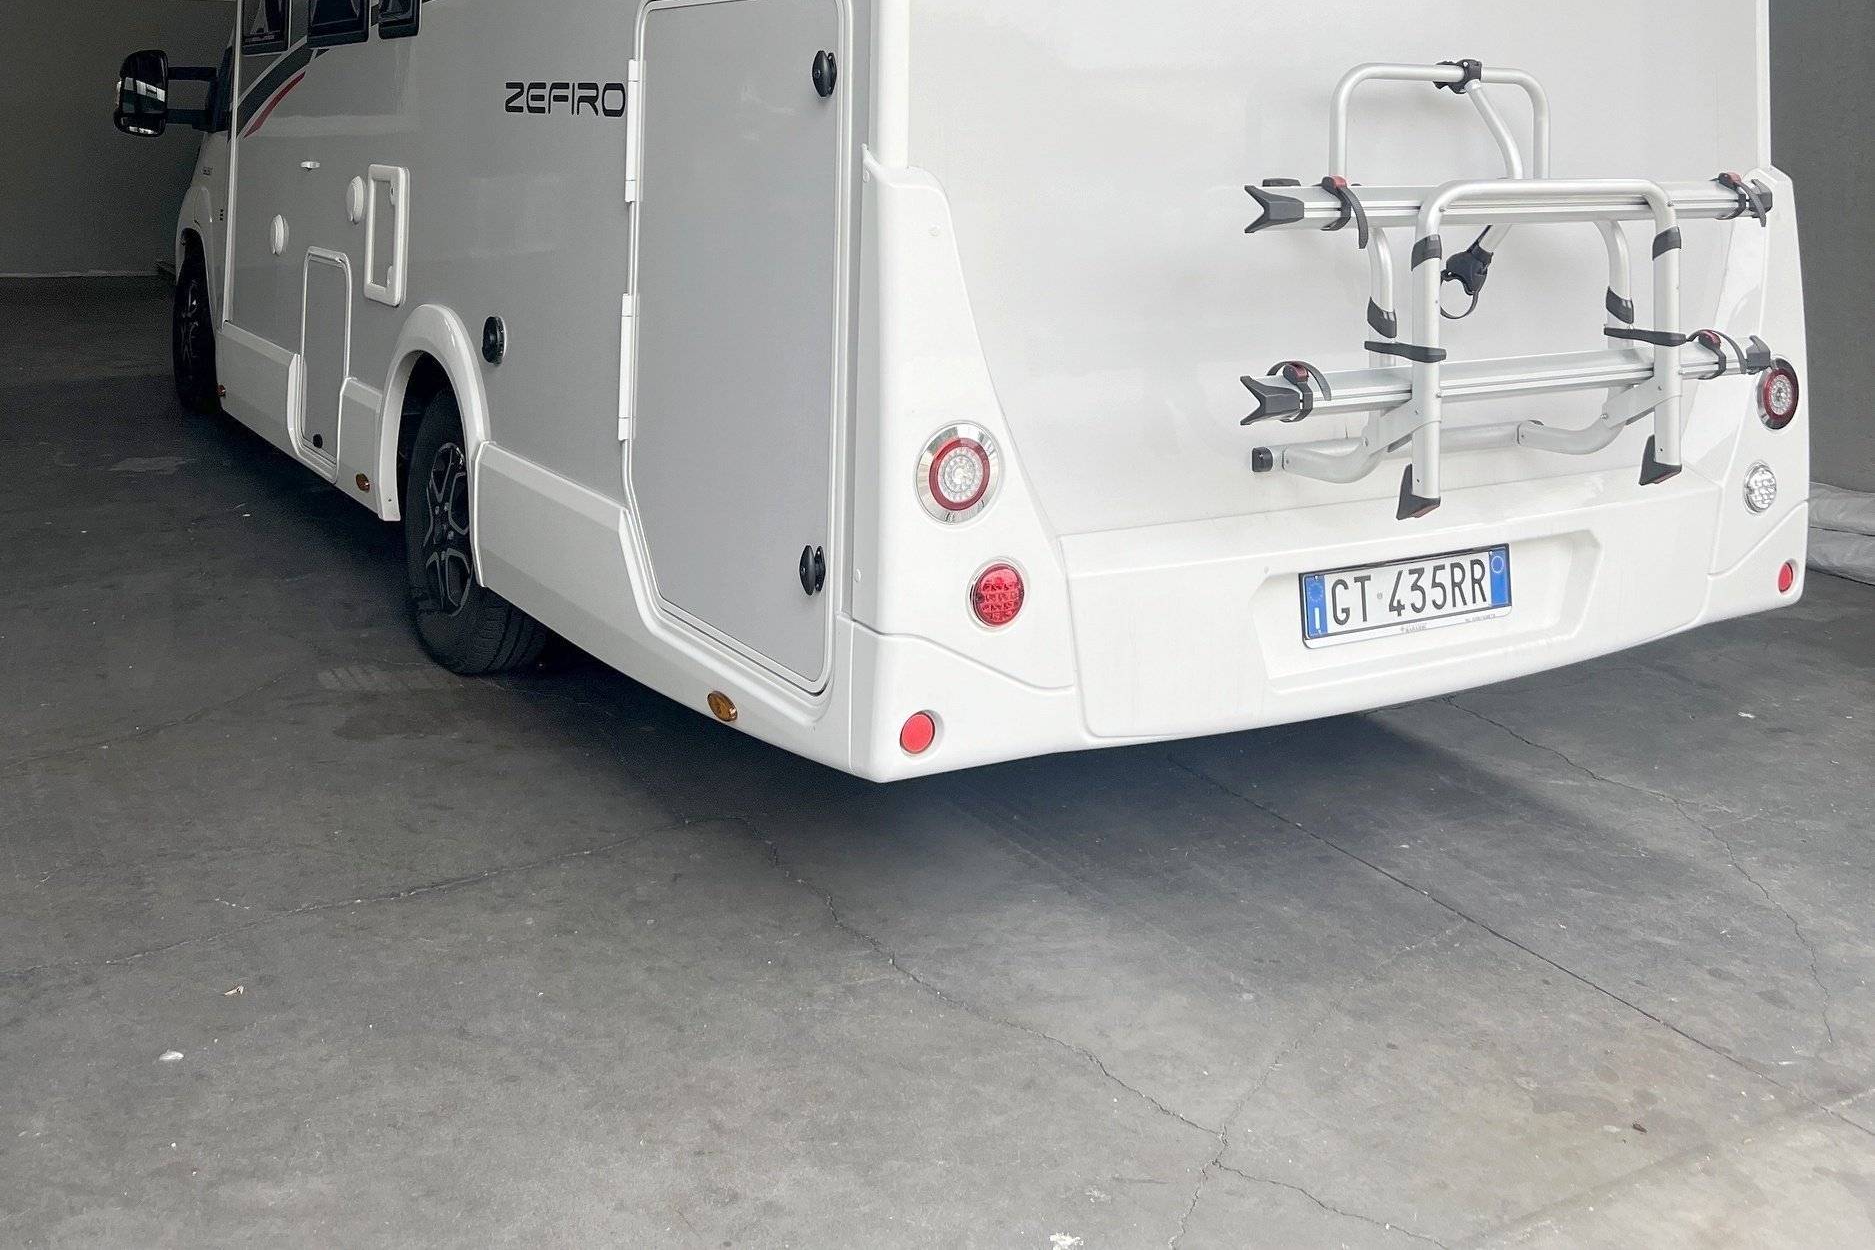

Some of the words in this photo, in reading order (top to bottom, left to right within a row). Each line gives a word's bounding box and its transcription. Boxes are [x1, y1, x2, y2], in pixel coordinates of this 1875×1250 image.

[505, 82, 626, 117] ZEFIRO
[1331, 575, 1371, 626] GT
[1388, 558, 1487, 617] 435RR
